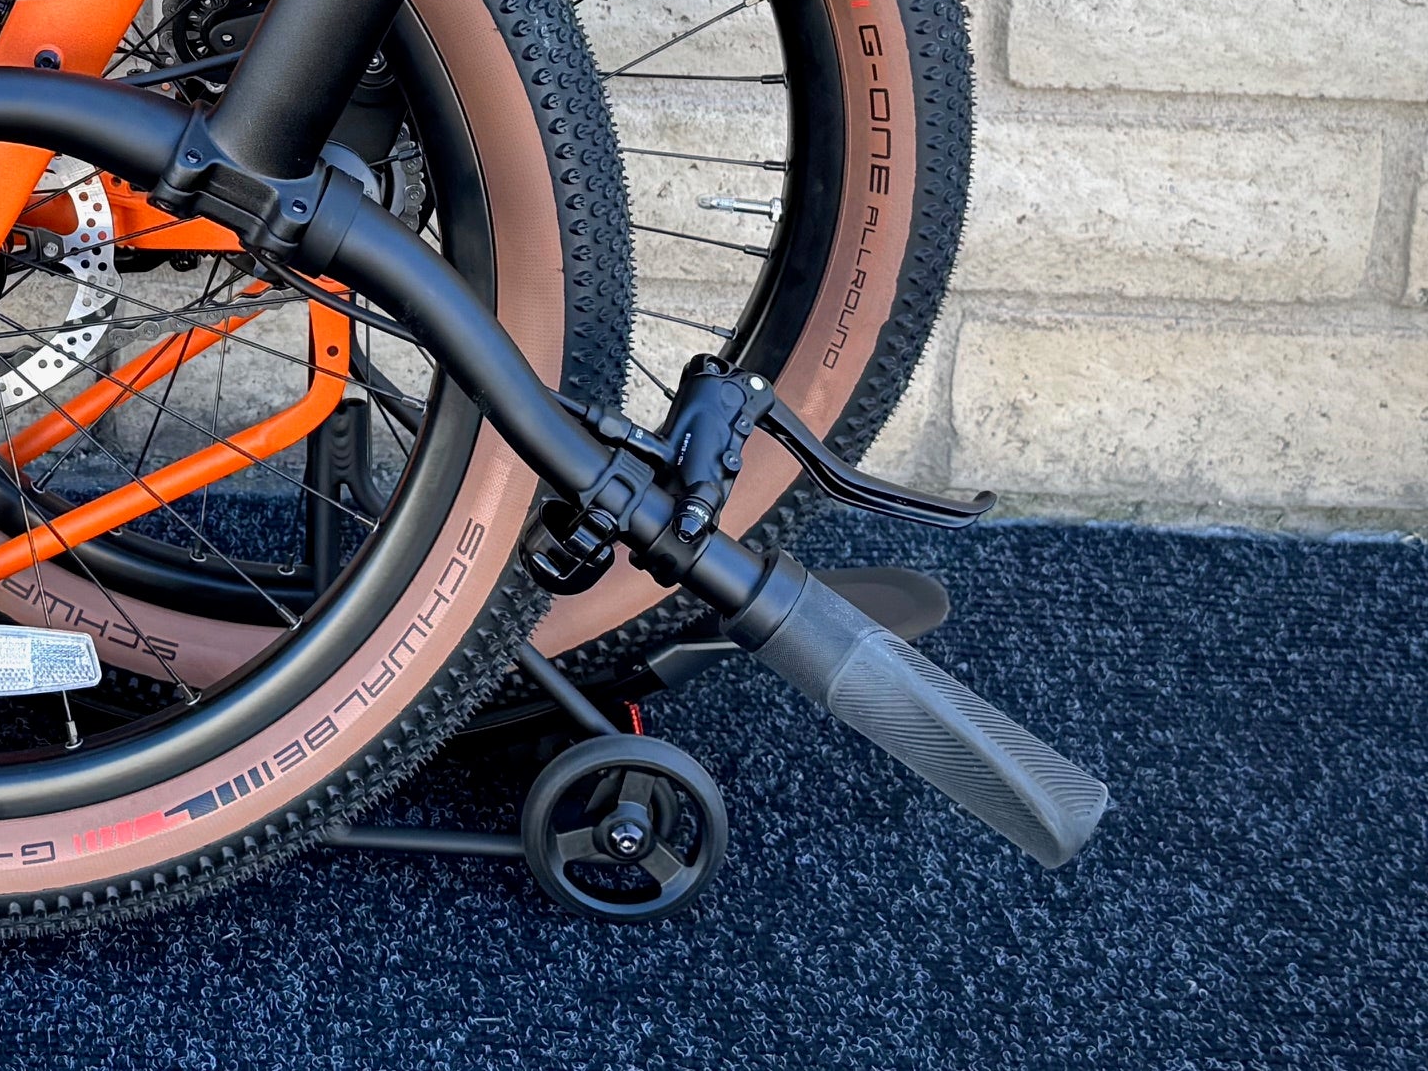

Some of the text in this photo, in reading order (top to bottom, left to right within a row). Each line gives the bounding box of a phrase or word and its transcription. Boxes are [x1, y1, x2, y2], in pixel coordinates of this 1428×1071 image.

[822, 24, 892, 369] G-ONE ALLROUND
[272, 517, 486, 773] SCHWALBE
